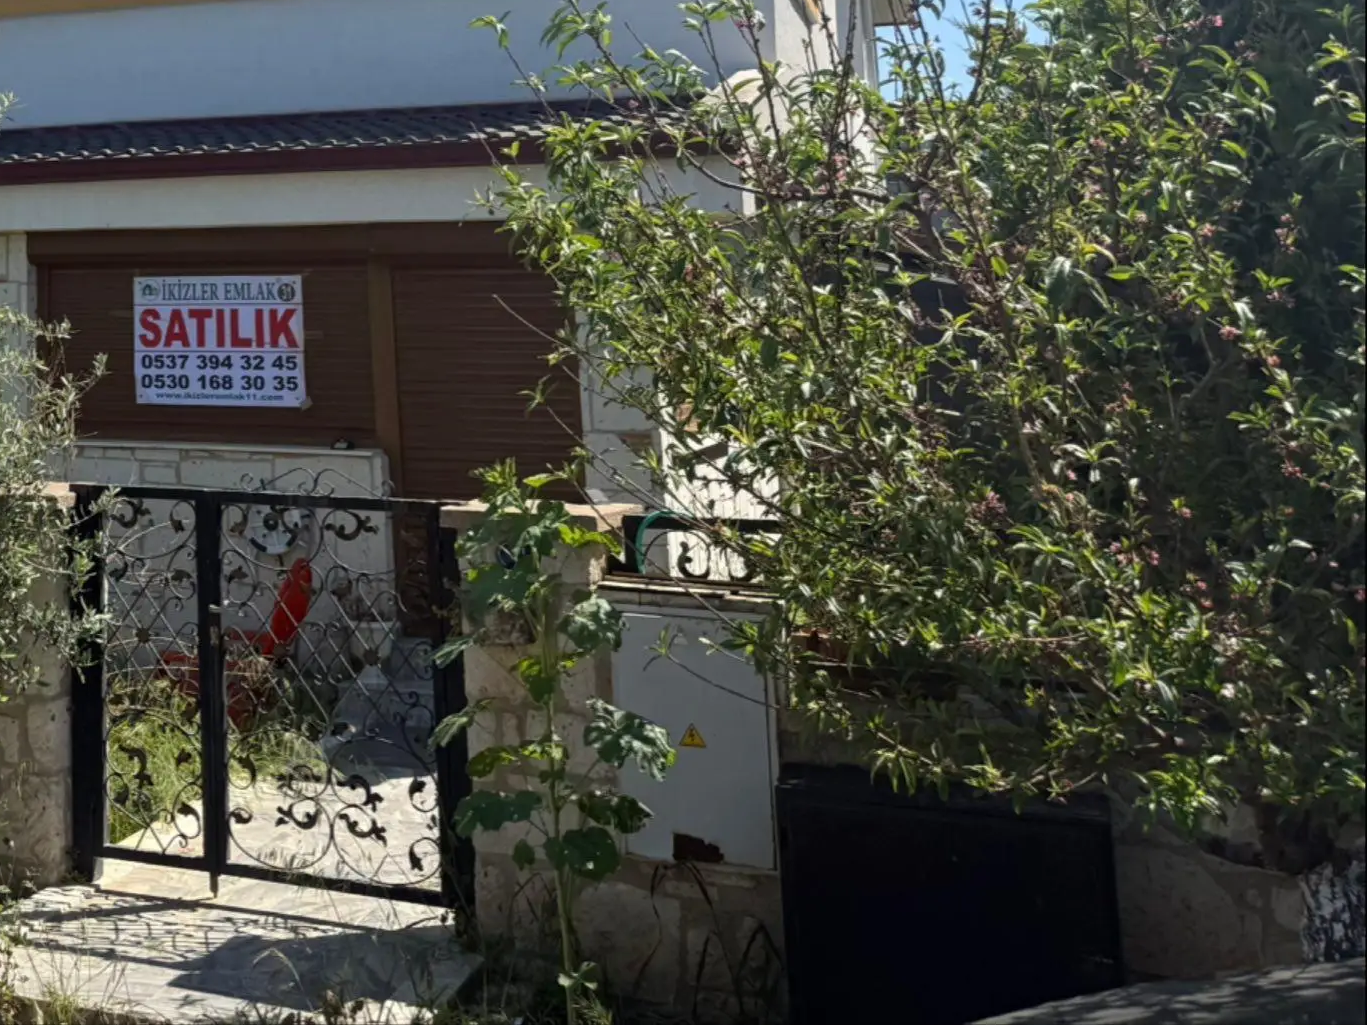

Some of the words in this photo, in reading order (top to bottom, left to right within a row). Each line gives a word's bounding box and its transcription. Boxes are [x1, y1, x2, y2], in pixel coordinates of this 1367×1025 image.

[162, 279, 219, 301] İKİZLER
[224, 282, 277, 301] EMLAK
[139, 308, 300, 349] SATILIK
[141, 355, 189, 370] 0537
[196, 355, 233, 370] 394
[240, 355, 265, 371] 32
[272, 356, 297, 371] 45
[141, 374, 190, 389] 0530
[197, 375, 233, 390] 168
[241, 375, 265, 391] 30
[273, 376, 298, 392] 35
